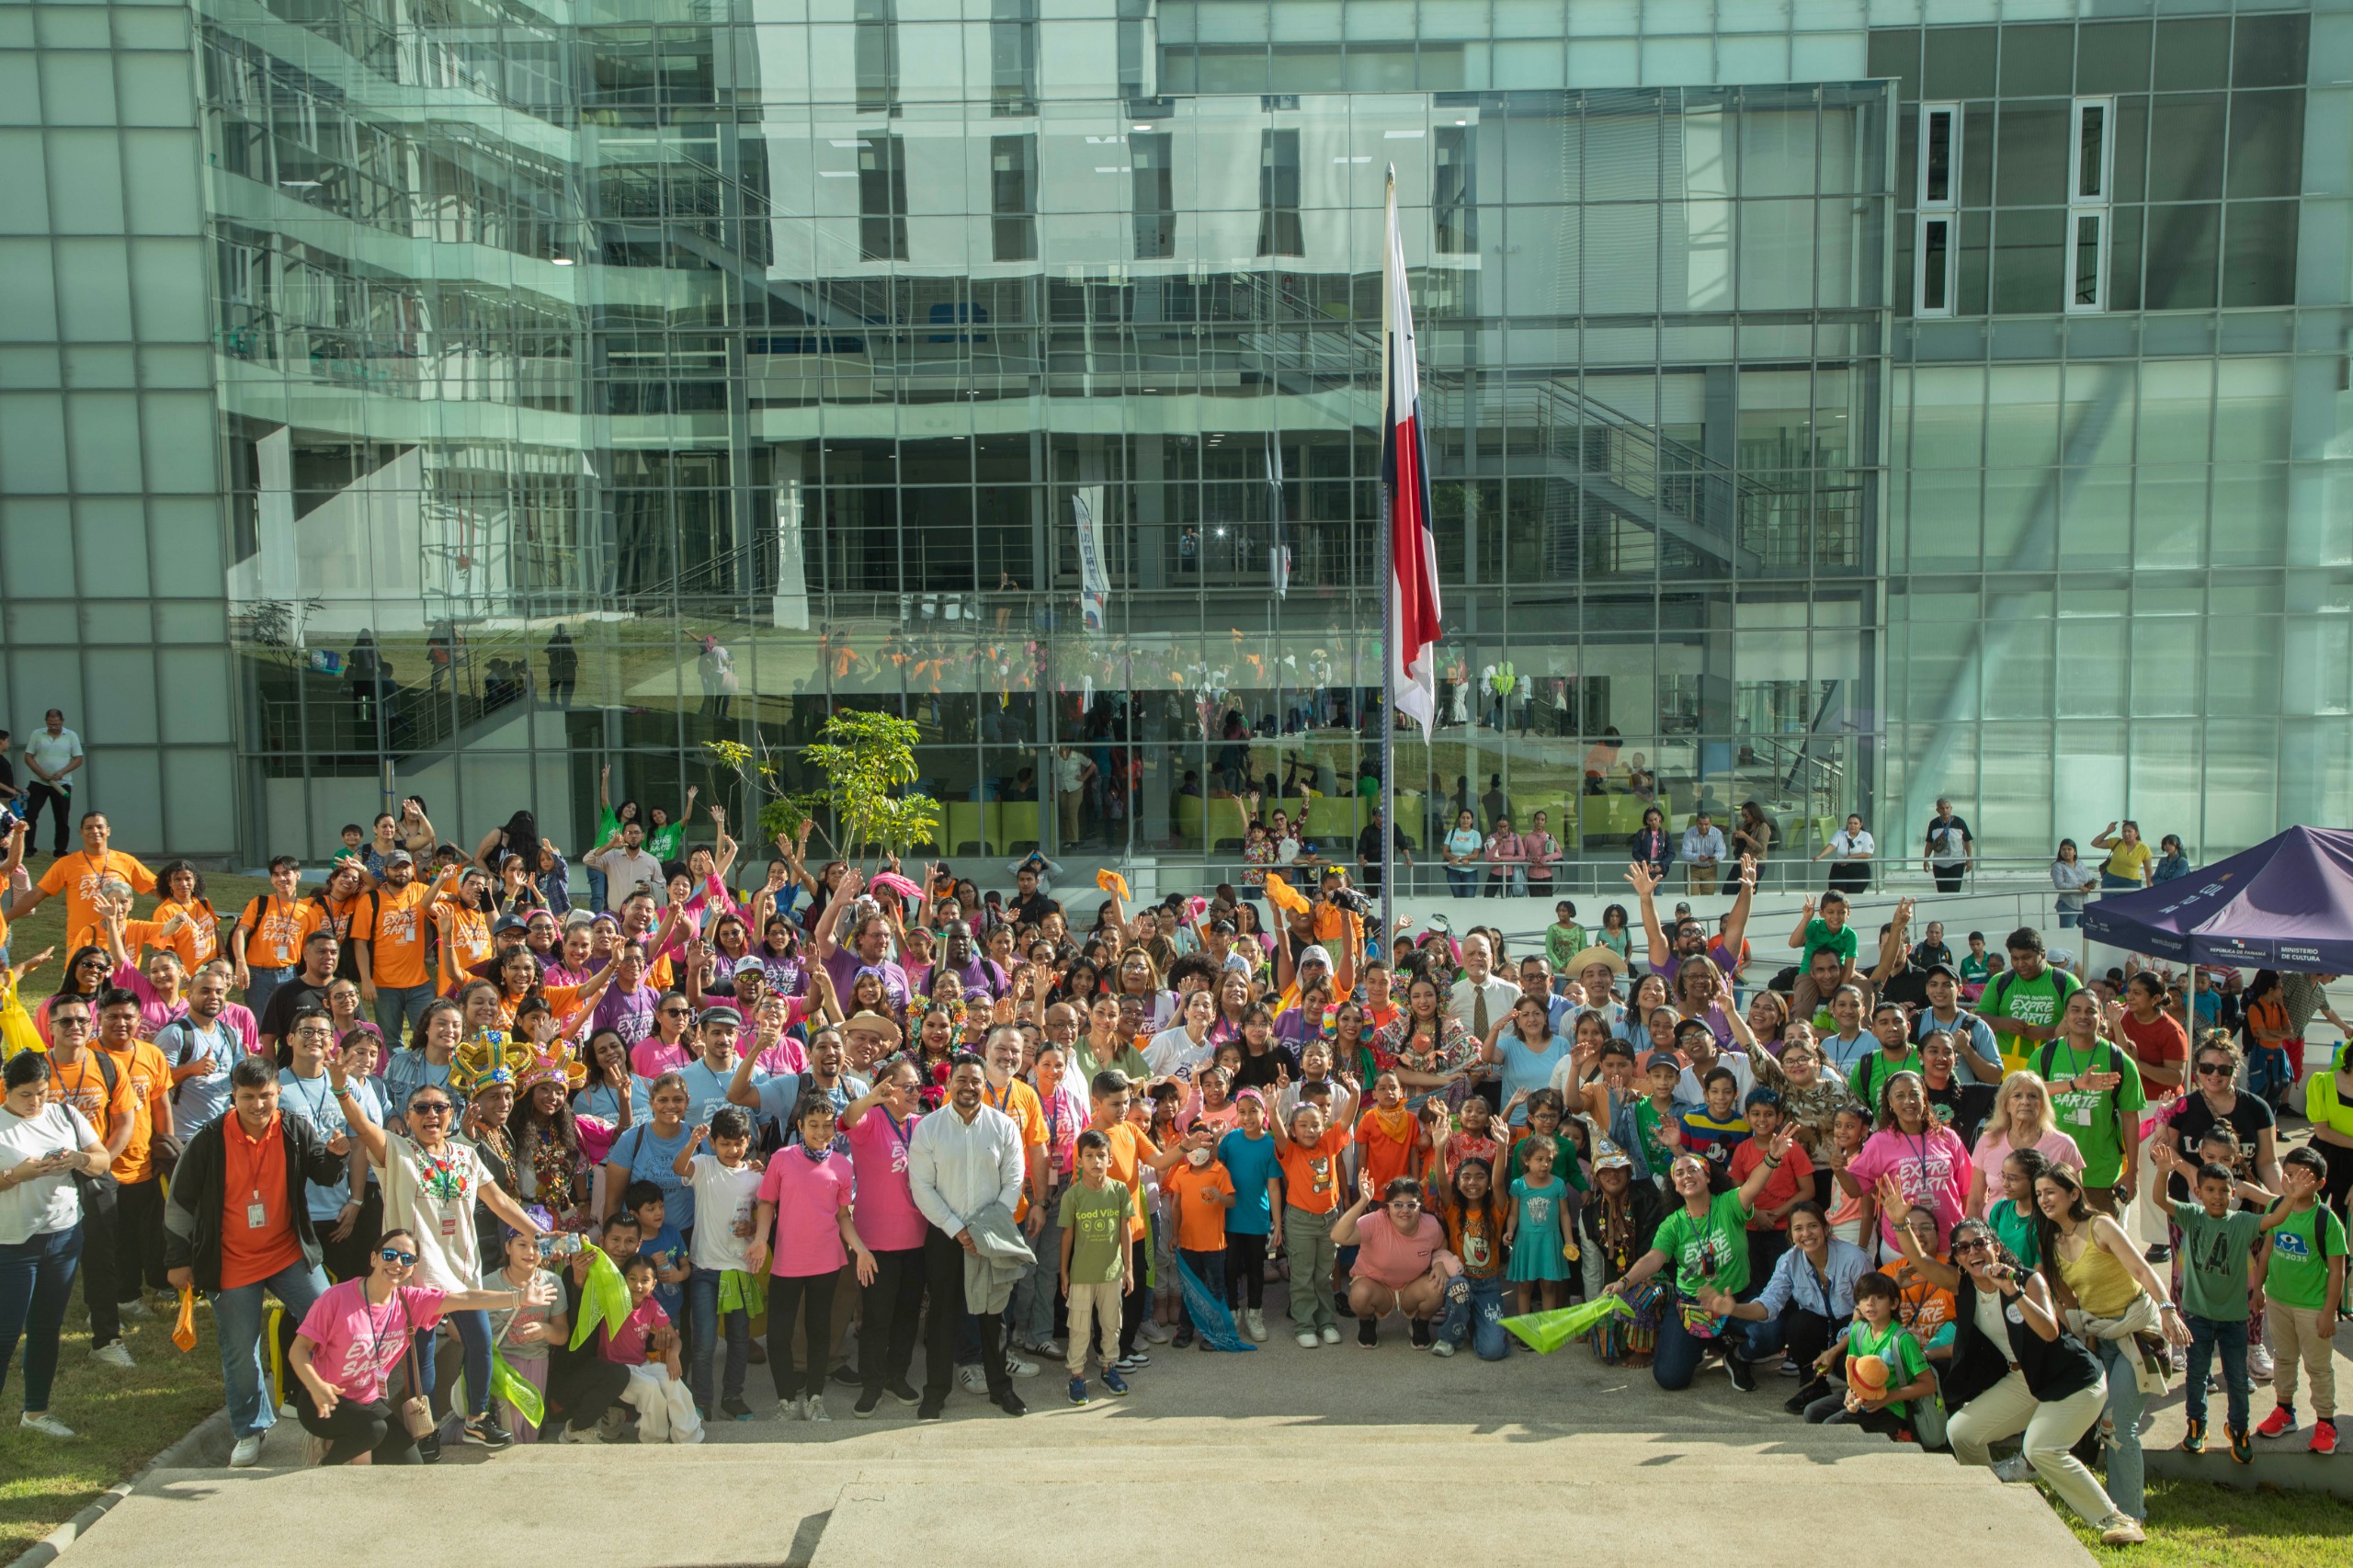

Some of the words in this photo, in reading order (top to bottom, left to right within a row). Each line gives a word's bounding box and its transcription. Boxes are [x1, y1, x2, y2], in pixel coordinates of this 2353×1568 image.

[2210, 947, 2235, 955] REPÚBLICA
[2280, 946, 2319, 955] MINISTERIO
[2009, 999, 2055, 1013] EXPRE
[2010, 1011, 2054, 1025] SARTE
[2053, 1093, 2102, 1108] SARTE
[2183, 1135, 2256, 1158] LE
[1899, 1160, 1950, 1180] EXPRE
[1527, 1196, 1552, 1208] HAPPY
[2285, 1253, 2308, 1263] 2035
